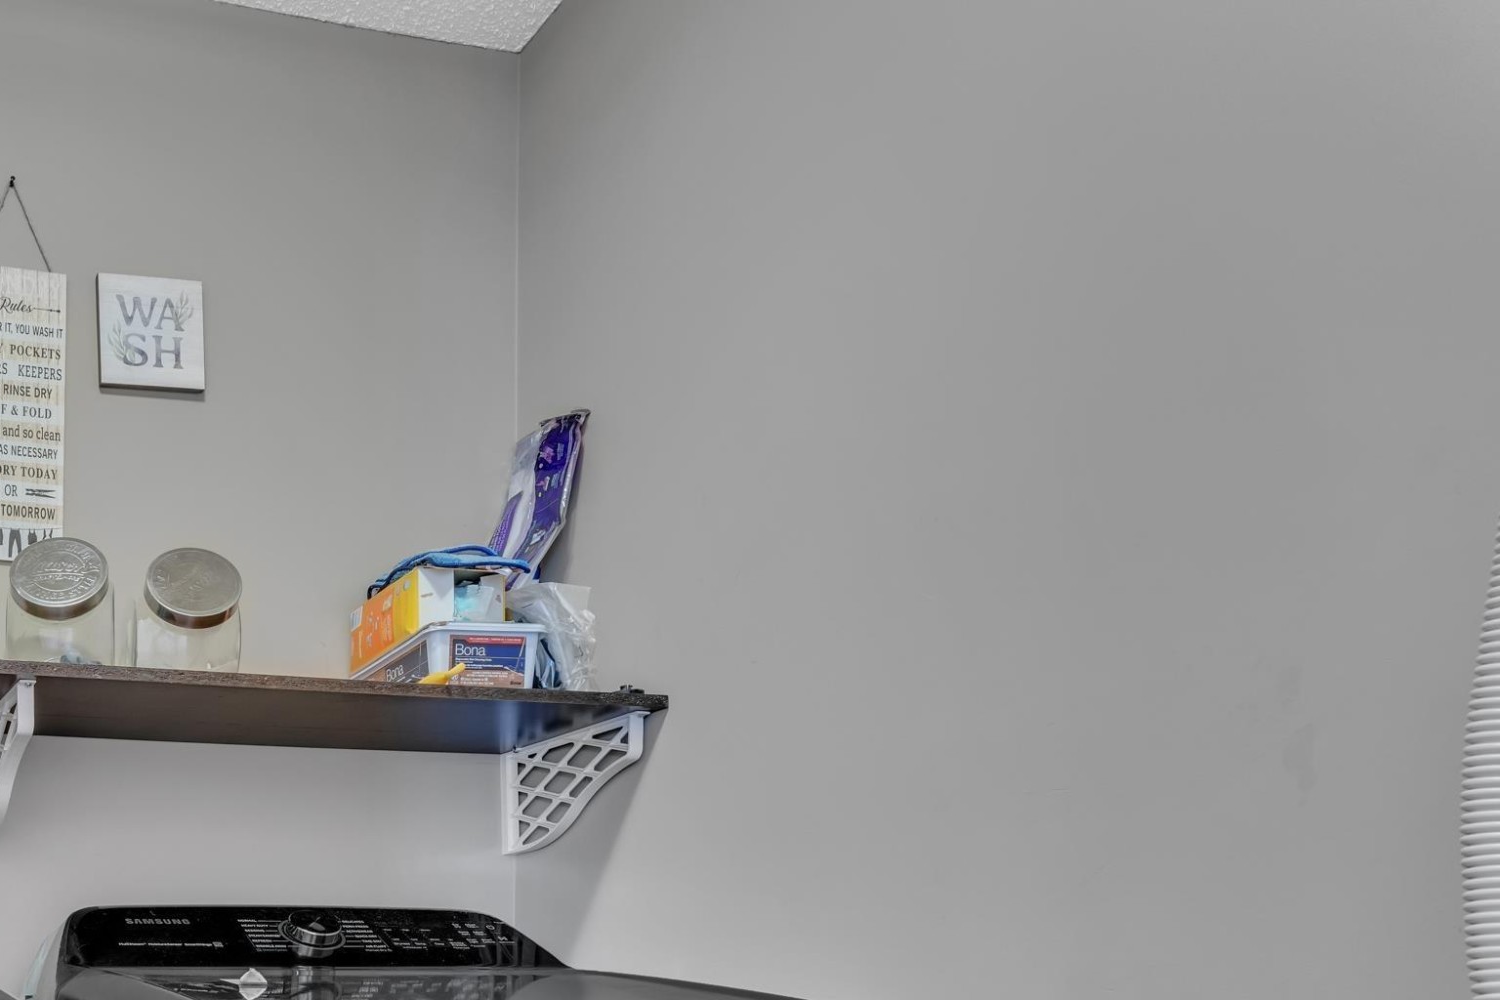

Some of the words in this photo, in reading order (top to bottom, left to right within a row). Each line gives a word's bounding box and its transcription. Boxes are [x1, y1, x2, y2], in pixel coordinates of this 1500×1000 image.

[116, 294, 185, 332] WA
[4, 322, 13, 334] IT,
[15, 323, 30, 335] YOU
[32, 325, 54, 338] WASH
[56, 328, 64, 339] IT
[9, 343, 61, 360] POCKETS
[122, 332, 184, 370] SH
[17, 363, 63, 381] KEEPERS
[3, 383, 31, 397] RINSE
[34, 387, 53, 400] DRY
[10, 404, 19, 416] &
[22, 405, 52, 420] FOLD
[2, 424, 20, 438] and
[22, 428, 34, 439] so
[36, 427, 61, 442] clean
[11, 445, 58, 460] NECESSARY
[20, 466, 58, 480] TODAY
[4, 484, 18, 497] OR
[0, 503, 56, 520] TOMORROW
[455, 643, 486, 657] Bona
[386, 664, 404, 682] Bona
